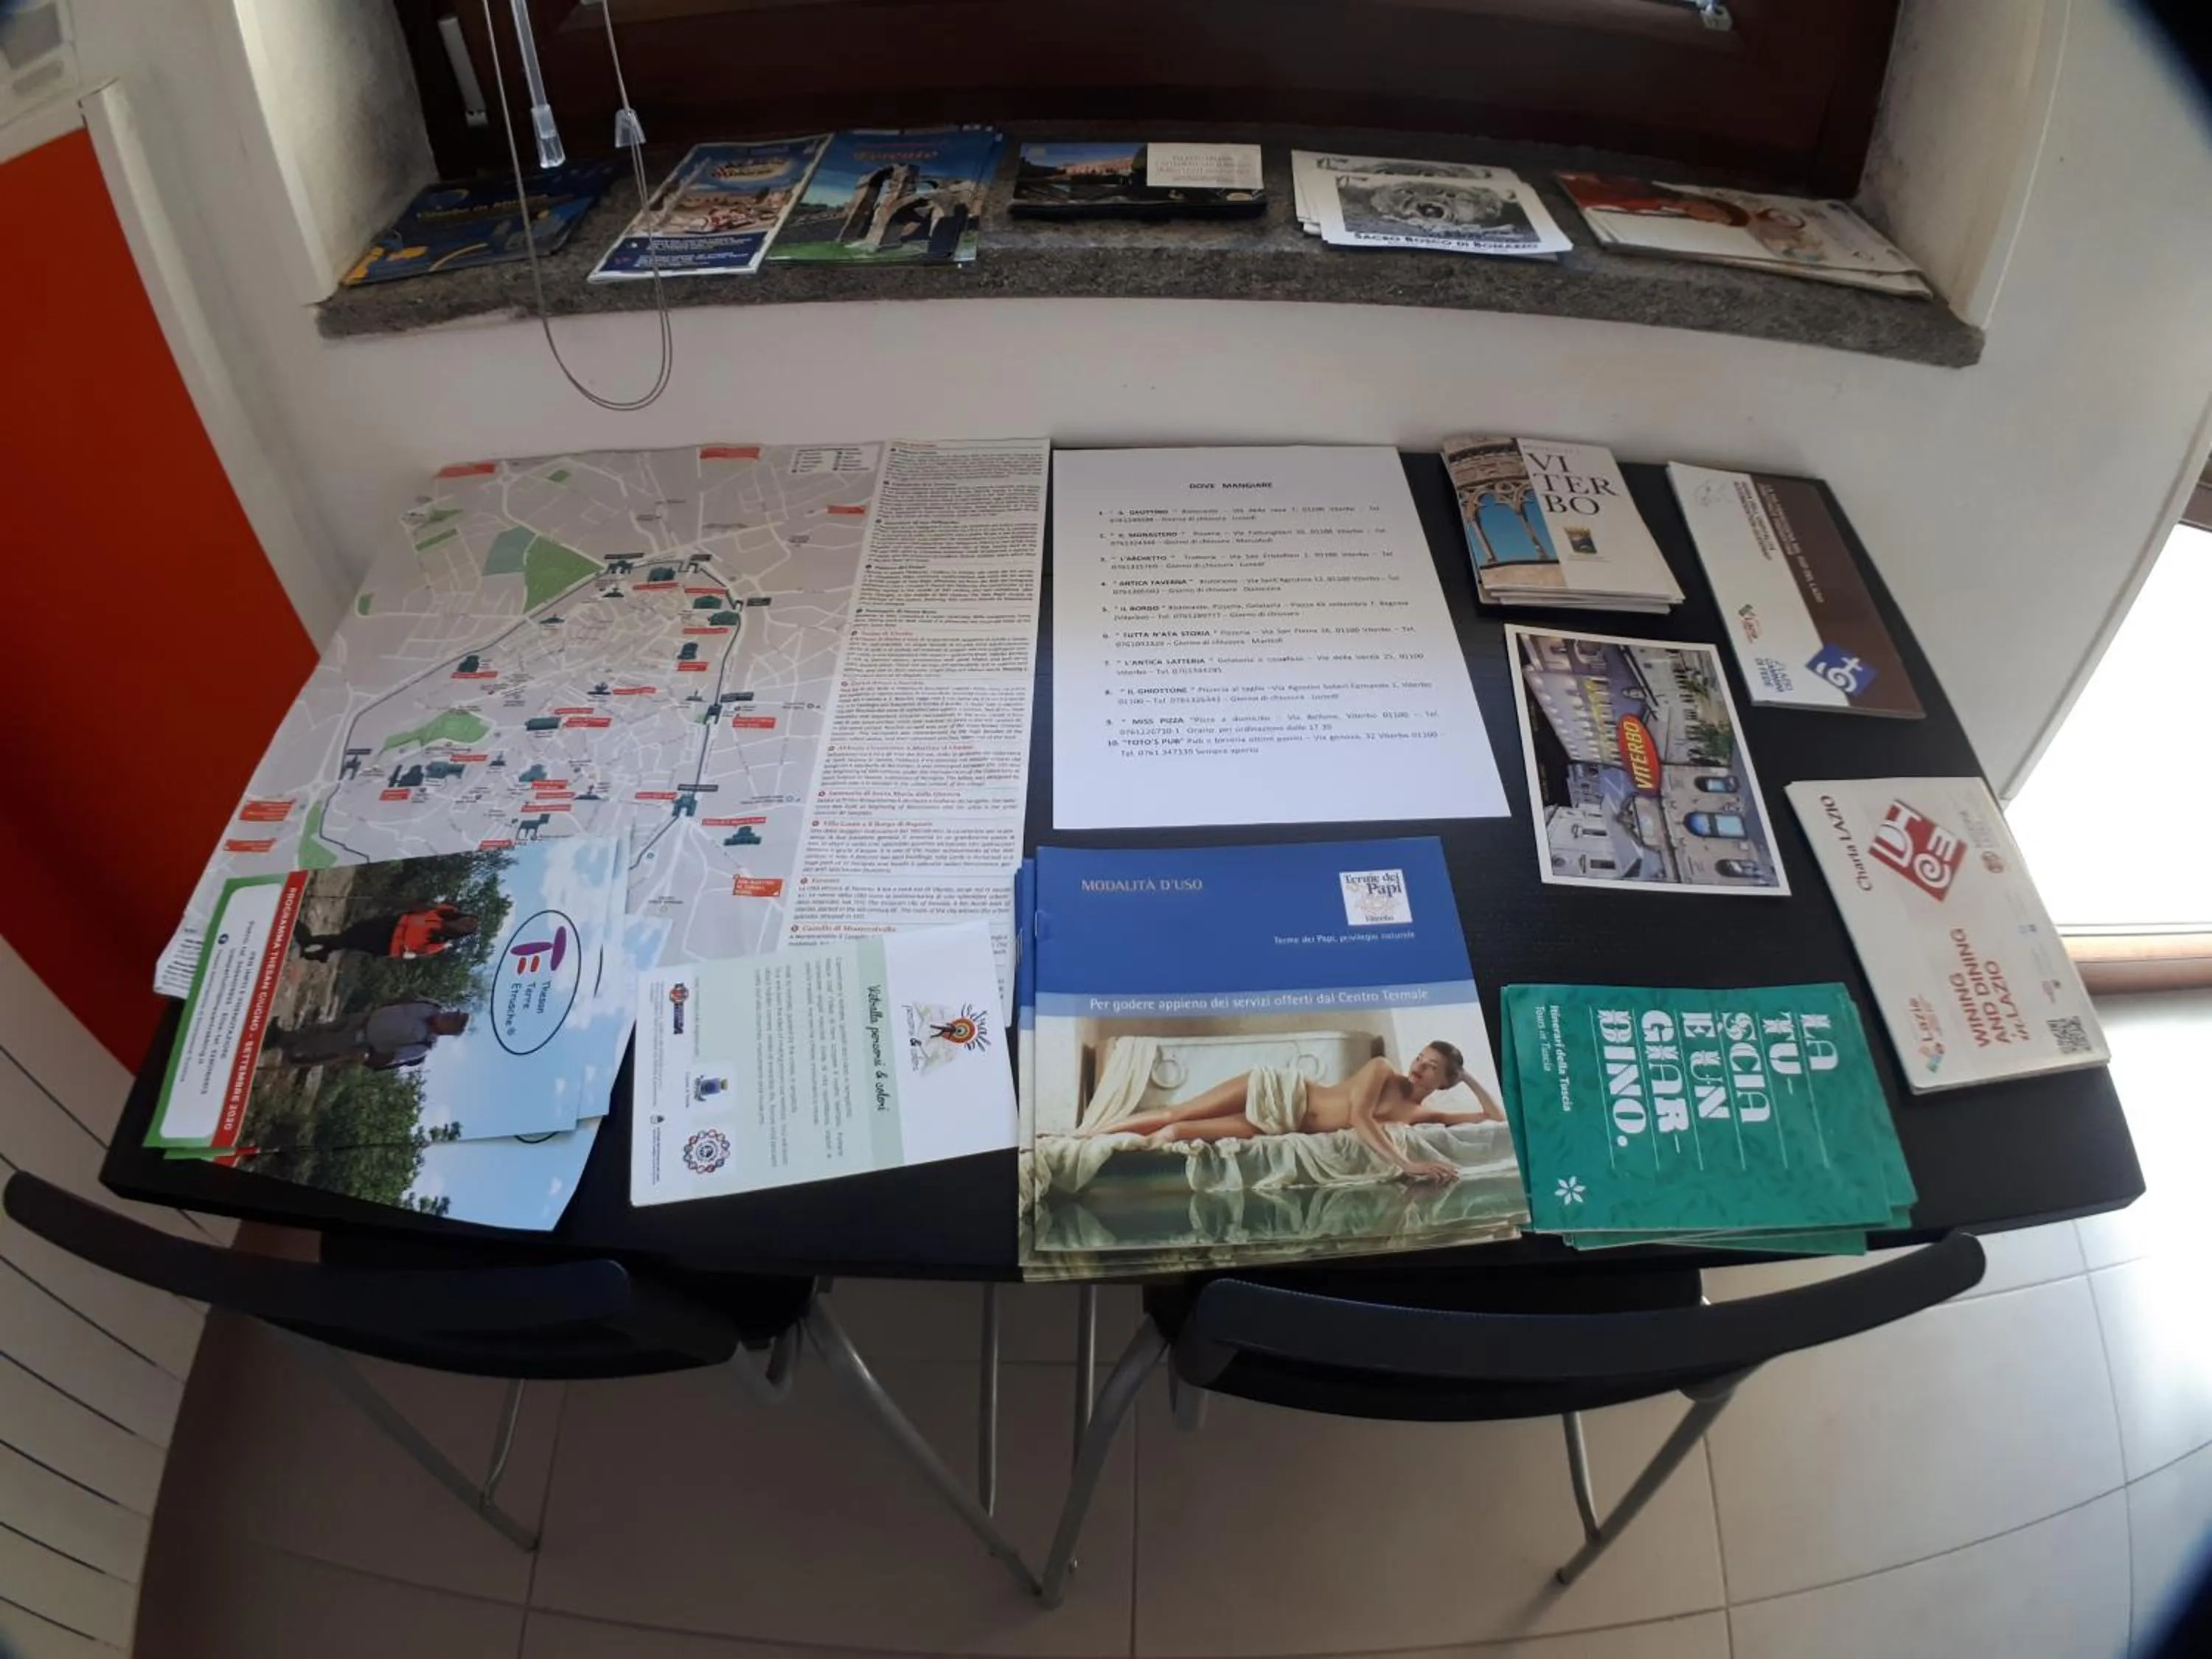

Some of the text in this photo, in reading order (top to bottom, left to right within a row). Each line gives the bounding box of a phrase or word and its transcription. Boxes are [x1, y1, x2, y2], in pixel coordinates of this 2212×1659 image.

[1527, 453, 1572, 473] VI
[1532, 473, 1620, 496] TER
[1541, 494, 1601, 515] BO
[1624, 720, 1656, 789] VITERBO
[1081, 877, 1203, 892] MODALITÀ D'USO
[1366, 883, 1402, 898] Papi
[274, 886, 297, 949] PROGRAMMA
[536, 979, 551, 1014] Thesan
[1090, 989, 1428, 1012] Per godere appieno dei servizi offerti dal Centro Termale
[1950, 928, 2013, 1044] AND DINING
[1985, 960, 2020, 1022] LAZIO
[1950, 973, 1991, 1048] WINING
[1800, 1014, 1840, 1071] LA
[1556, 1049, 1568, 1074] della
[1721, 1012, 1771, 1124] SCIA
[1559, 1077, 1573, 1111] Tuscia
[1689, 1050, 1731, 1119] UN
